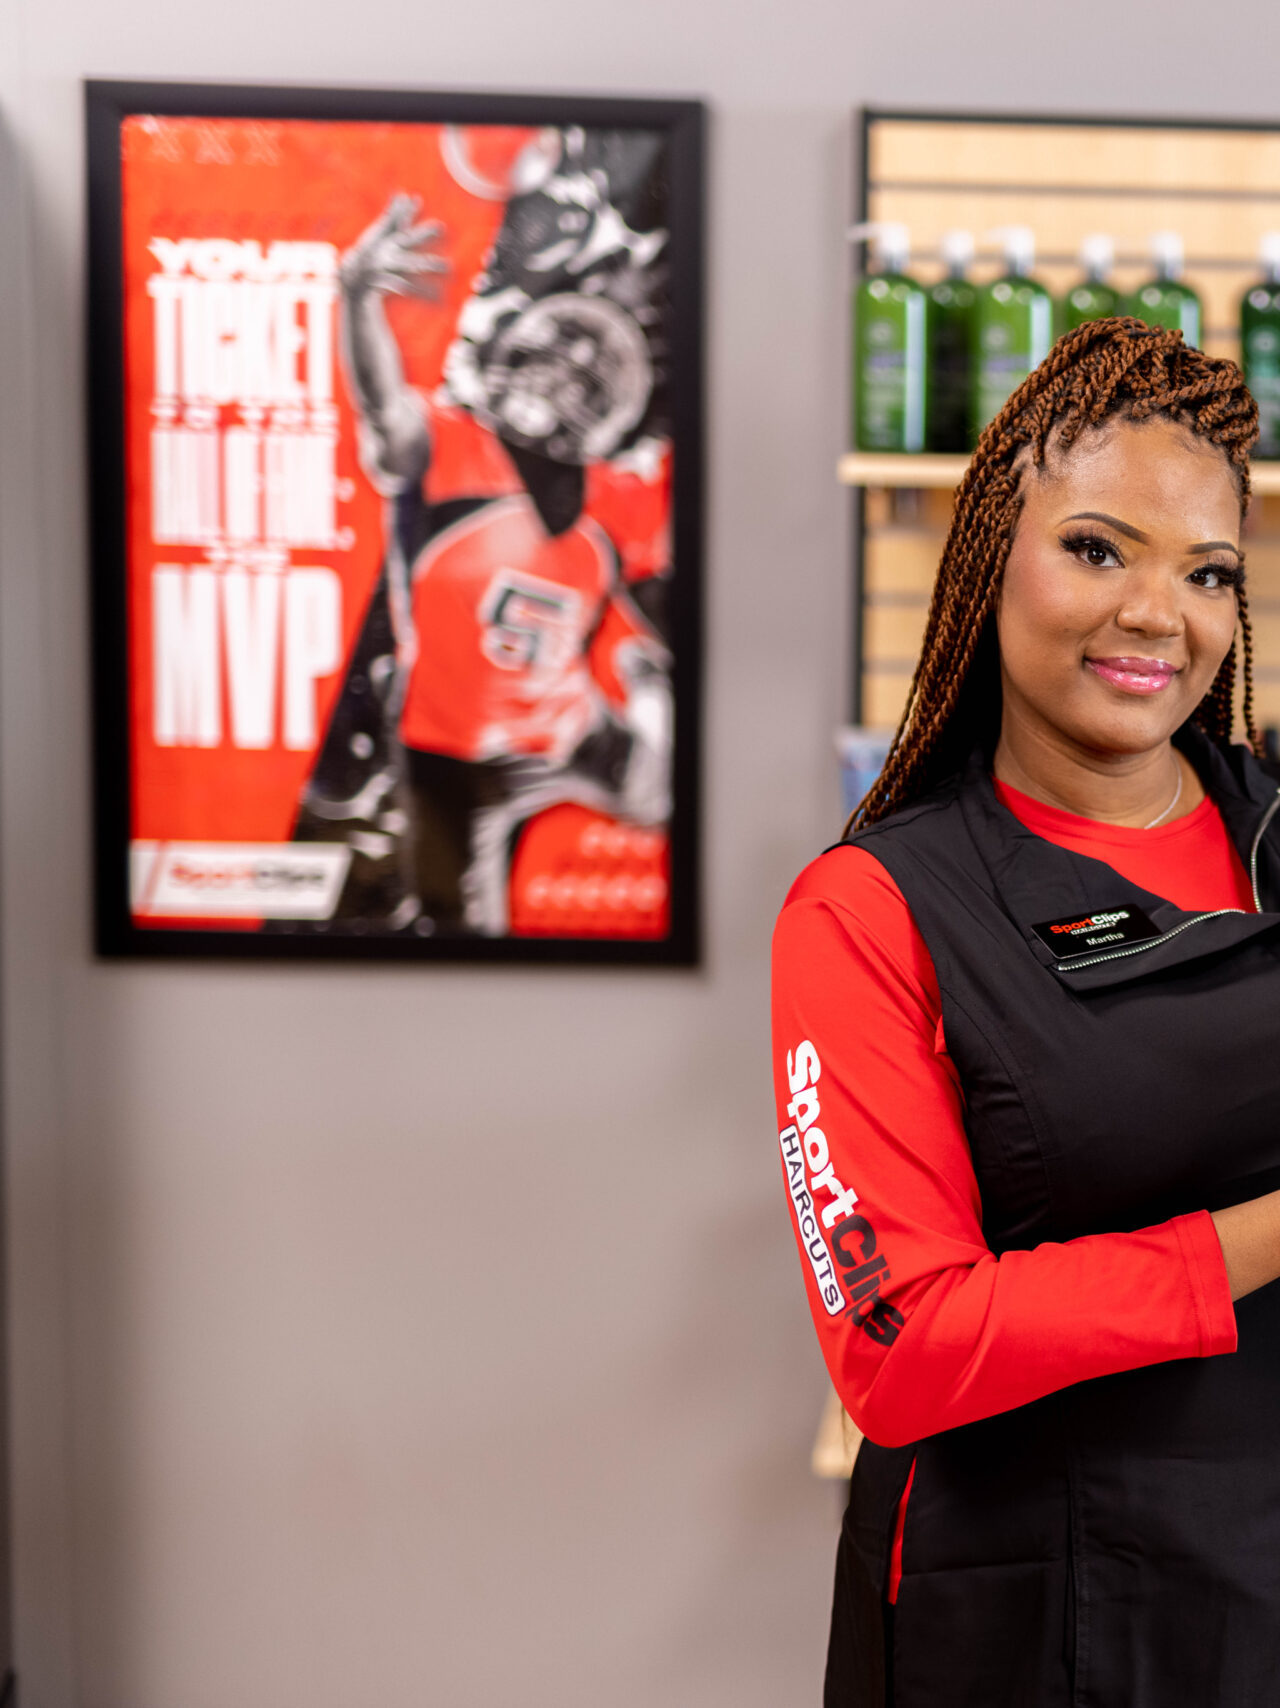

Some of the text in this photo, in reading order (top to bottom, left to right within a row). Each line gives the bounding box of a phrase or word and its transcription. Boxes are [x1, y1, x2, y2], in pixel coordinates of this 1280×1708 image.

[148, 237, 339, 281] YOUR
[148, 277, 338, 403] TICKET
[152, 563, 341, 752] MVP
[1050, 910, 1130, 934] SportClips
[1086, 932, 1125, 946] Martha
[781, 1131, 839, 1309] HAIRCUTS
